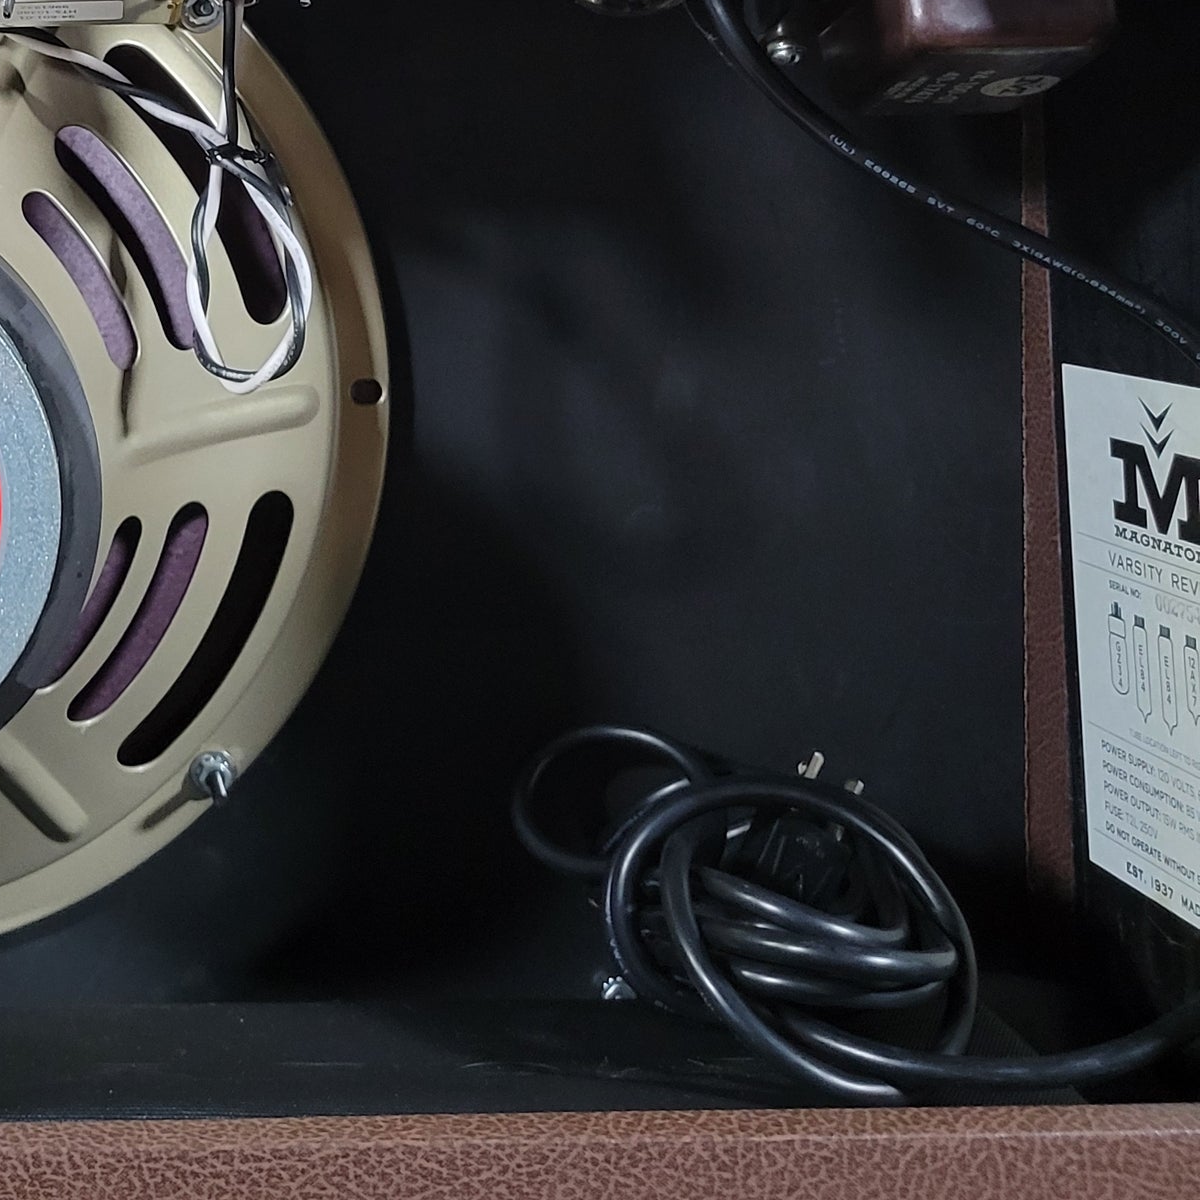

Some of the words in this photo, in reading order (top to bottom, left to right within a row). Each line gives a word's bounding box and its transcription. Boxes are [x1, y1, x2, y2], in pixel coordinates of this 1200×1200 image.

[829, 134, 856, 156] (UL)
[1156, 319, 1188, 345] 300V
[1113, 524, 1200, 564] MAGNATO
[1108, 550, 1163, 583] VARSITY
[1101, 739, 1127, 760] POWER
[1102, 759, 1128, 782] POWER
[1104, 780, 1129, 802] POWER
[1105, 820, 1115, 834] DO
[1117, 826, 1131, 843] NOT
[1131, 835, 1163, 862] OPERATE
[1150, 875, 1174, 900] 1937
